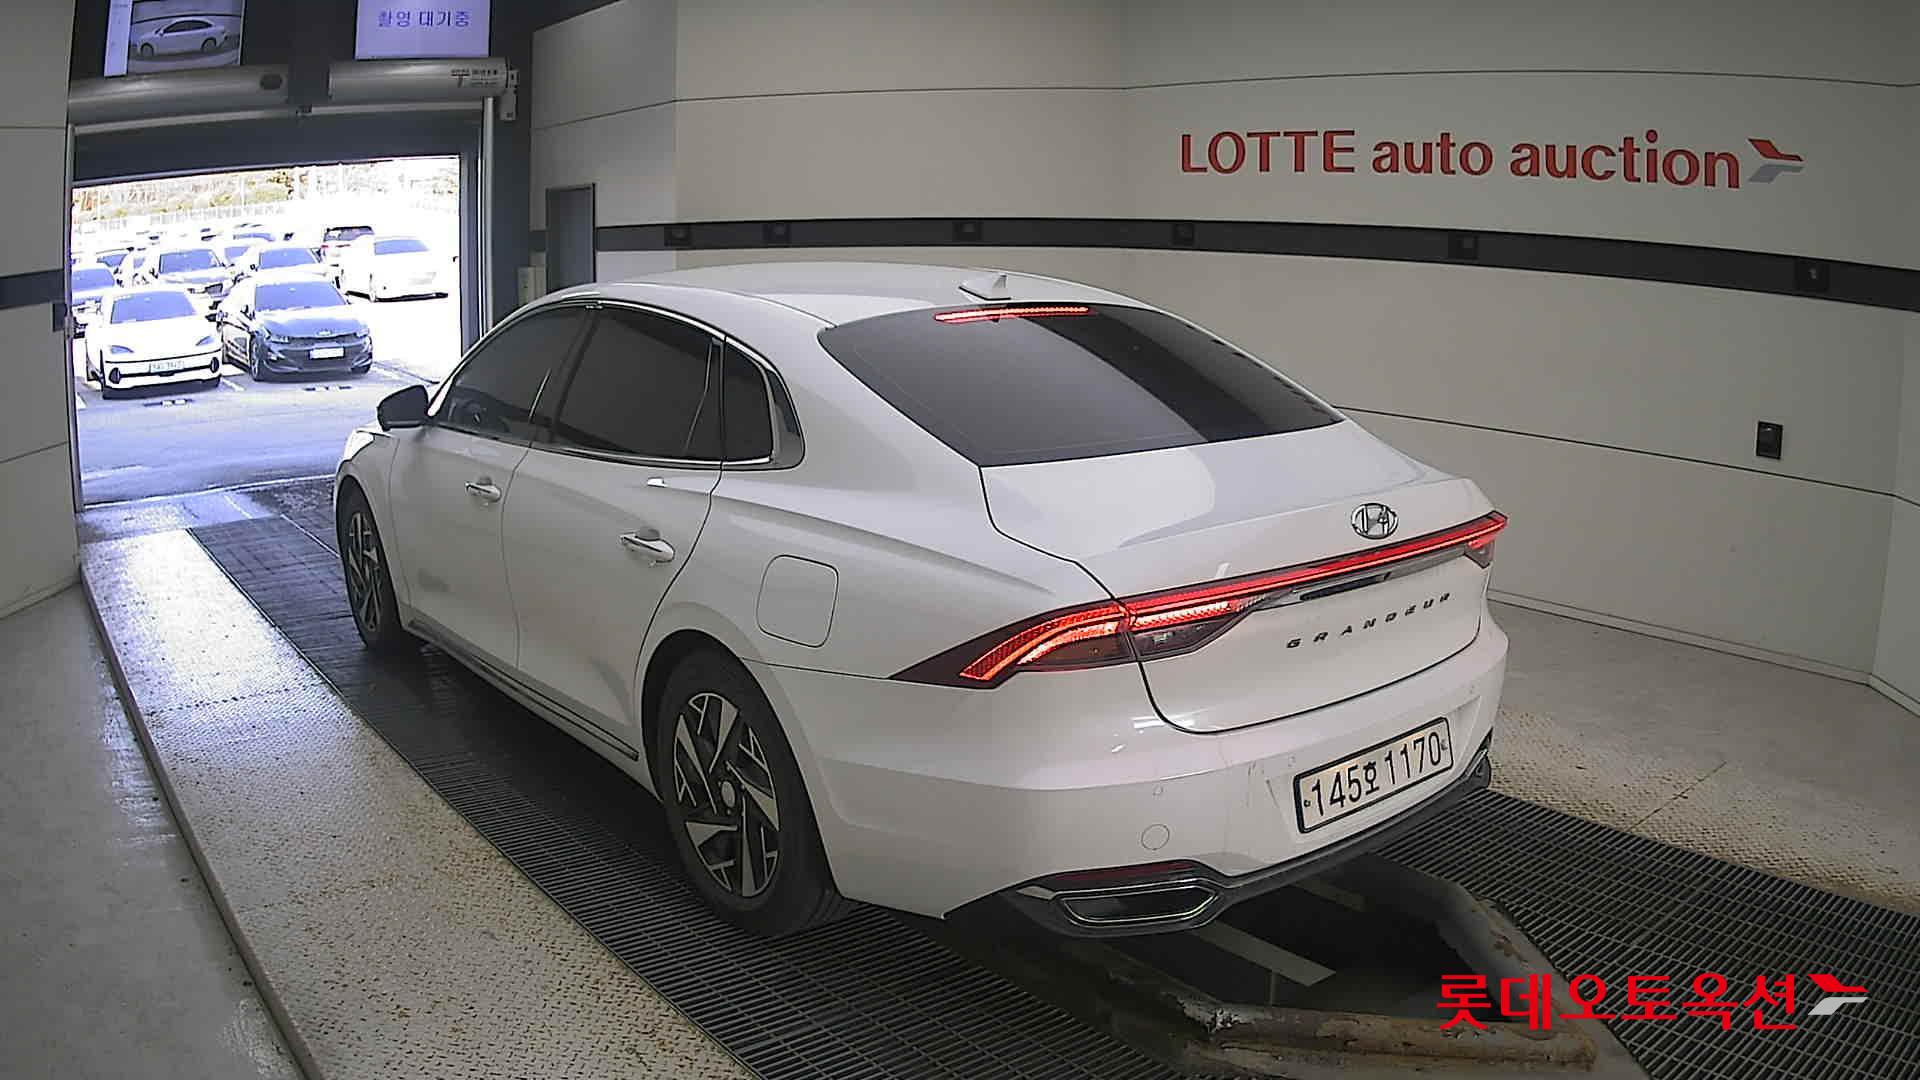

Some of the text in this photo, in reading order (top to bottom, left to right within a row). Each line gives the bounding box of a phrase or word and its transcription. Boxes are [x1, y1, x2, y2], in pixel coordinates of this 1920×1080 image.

[1180, 129, 1741, 189] LOTTE auto auction
[1286, 592, 1451, 649] GRANDEUR
